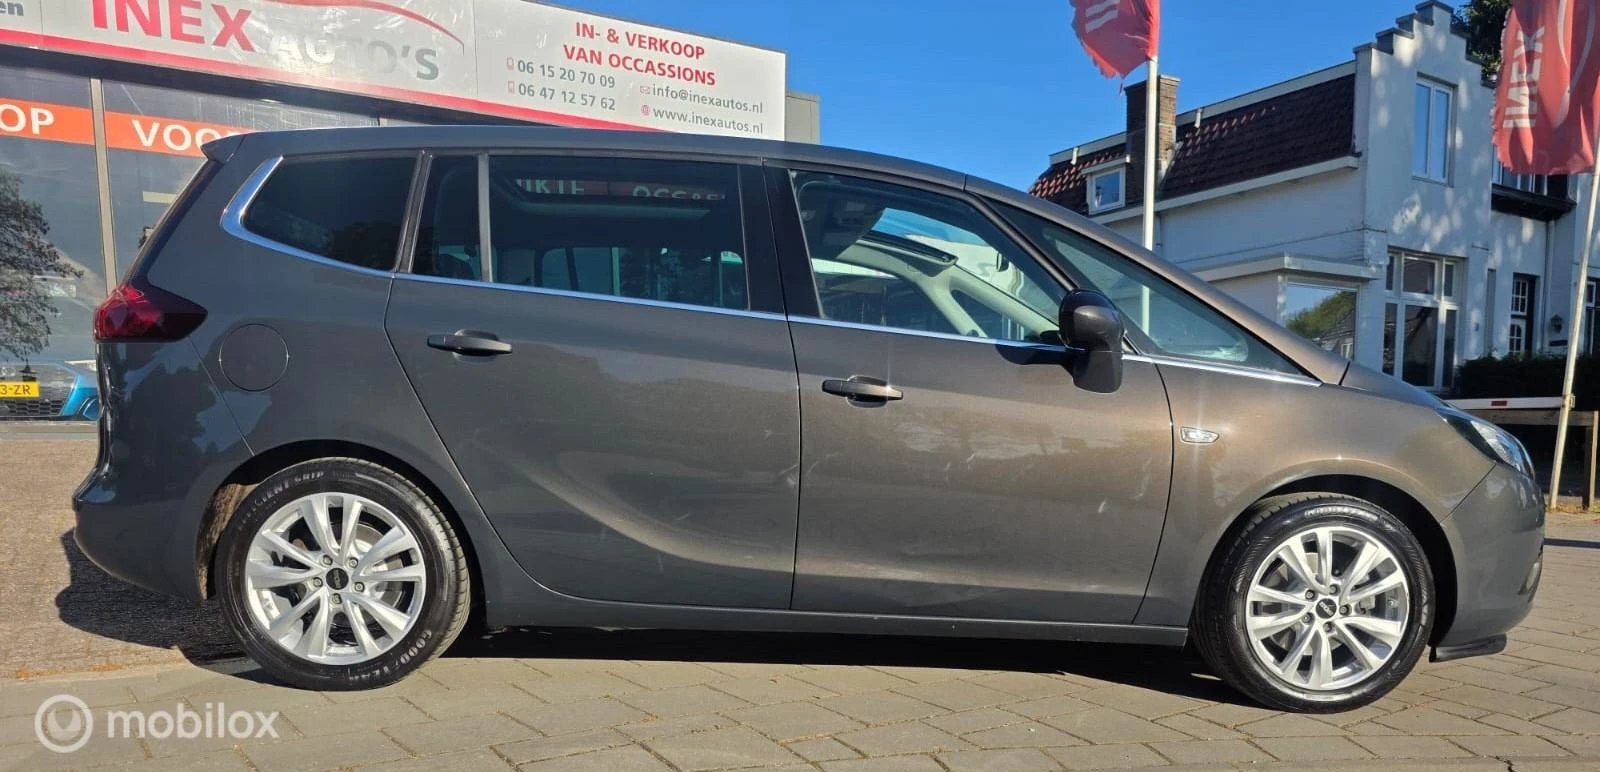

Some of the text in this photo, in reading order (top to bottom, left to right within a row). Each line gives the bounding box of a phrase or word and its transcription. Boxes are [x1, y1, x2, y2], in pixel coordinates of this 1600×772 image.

[92, 0, 439, 80] INEX AUTO'S
[576, 22, 705, 60] IN- & VERKOOP
[518, 59, 615, 88] 06 15 20 70 09
[563, 44, 716, 86] VAN OCCASSIONS
[1502, 25, 1545, 129] INEX
[519, 83, 615, 110] 06 47 12 57 62
[653, 83, 763, 114] info@inexautos.nl
[0, 104, 54, 135] OP
[653, 108, 763, 134] www.inexautos.nl
